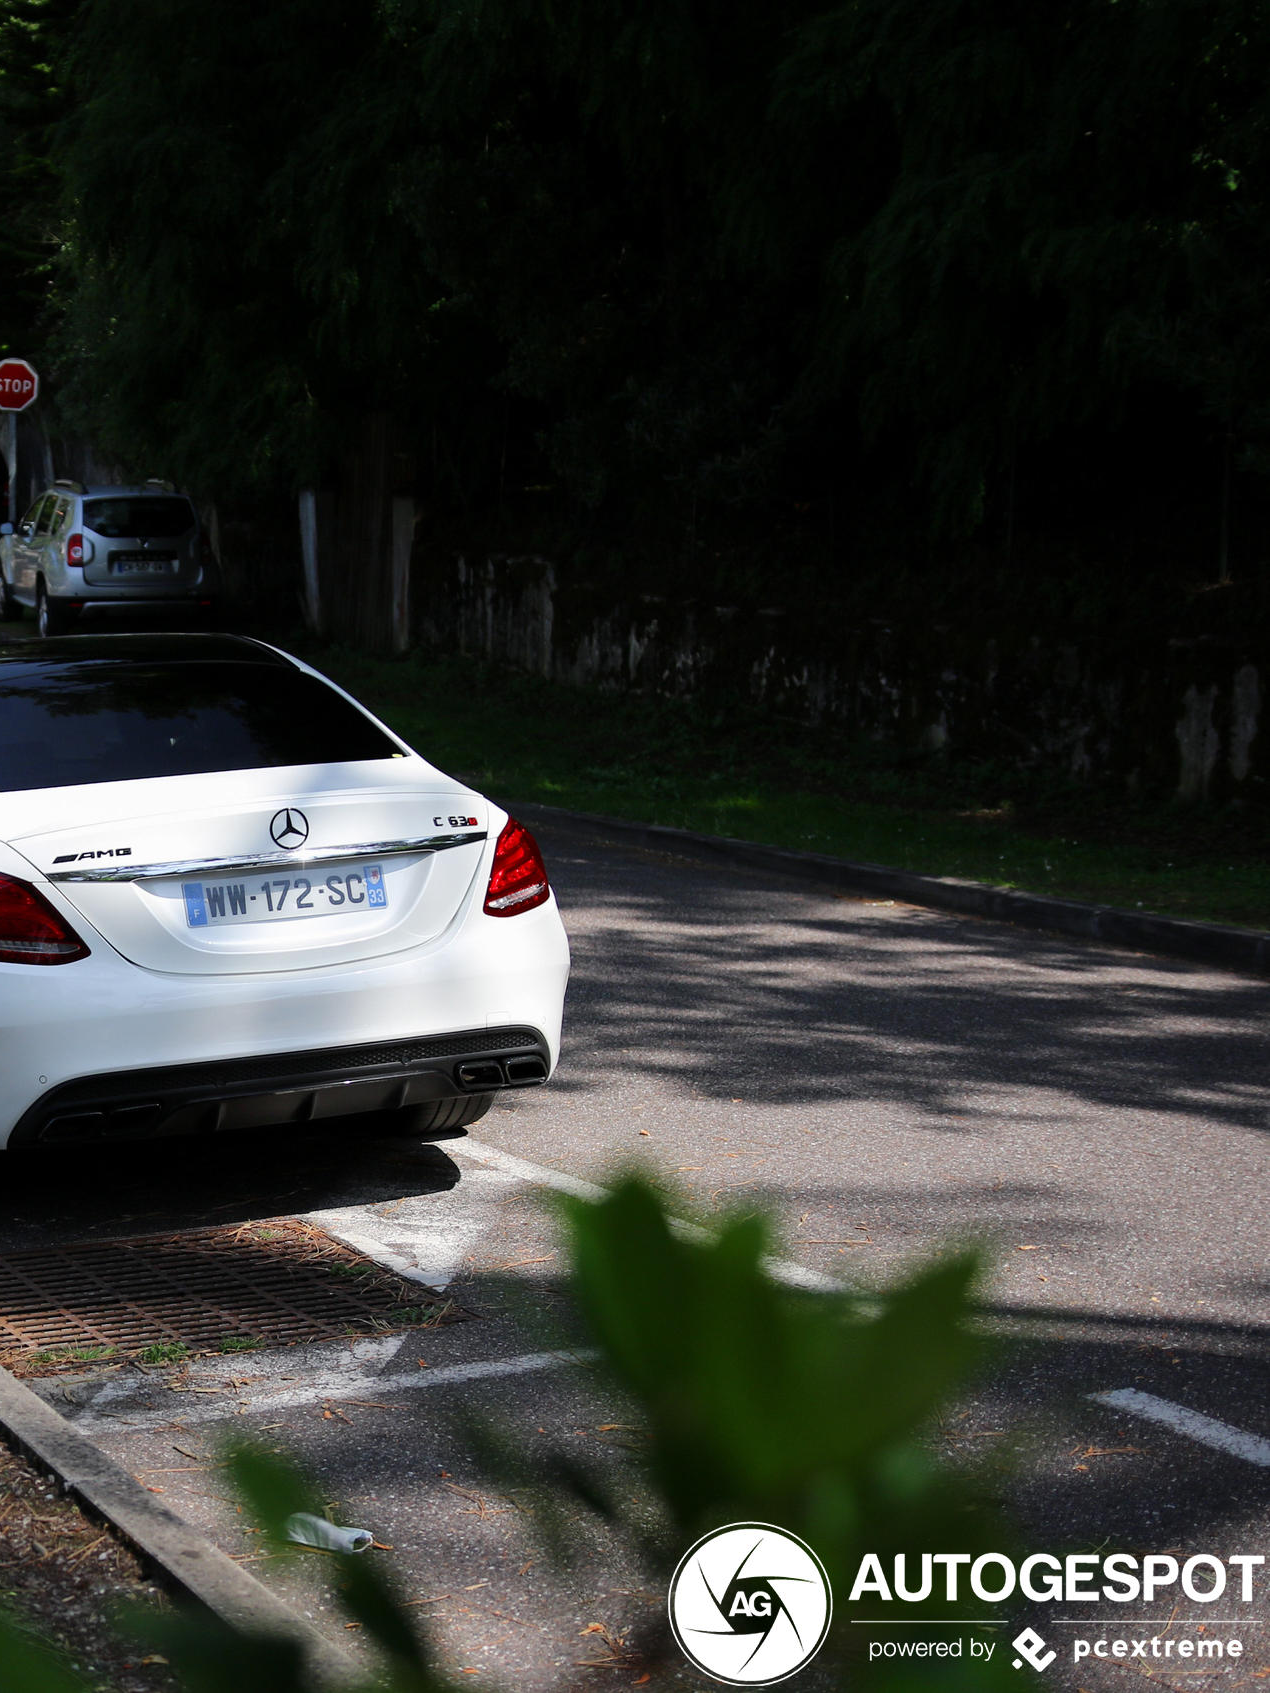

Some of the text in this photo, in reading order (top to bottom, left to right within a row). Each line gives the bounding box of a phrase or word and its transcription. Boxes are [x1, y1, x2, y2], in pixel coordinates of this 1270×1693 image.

[432, 816, 444, 827] C
[77, 847, 132, 861] AMG
[193, 873, 385, 919] F WW-172-SC 33
